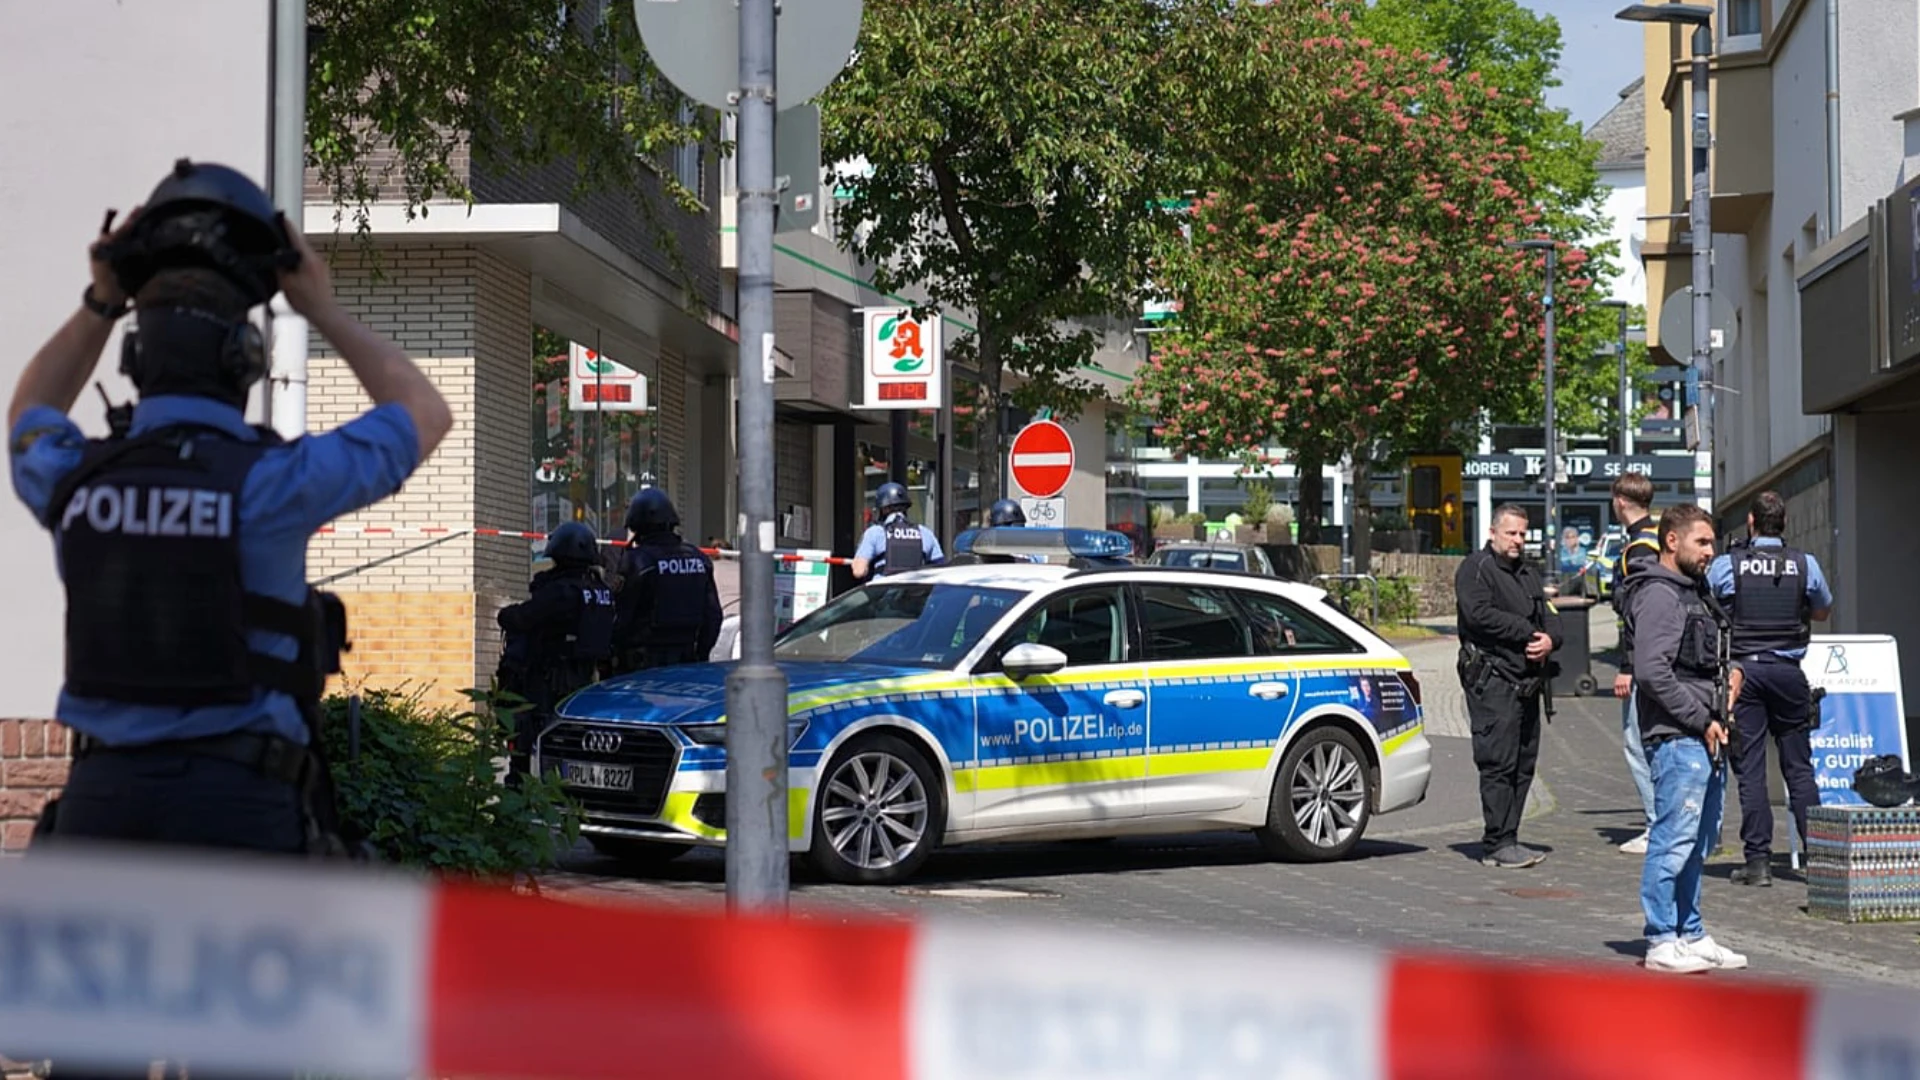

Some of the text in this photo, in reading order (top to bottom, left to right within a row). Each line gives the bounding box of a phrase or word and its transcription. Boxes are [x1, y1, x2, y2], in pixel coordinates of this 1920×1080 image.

[62, 485, 232, 536] POLIZEI
[1740, 559, 1798, 575] POLIEI
[980, 714, 1143, 747] www.POLIZEI.rlp.de
[603, 768, 632, 790] 8227
